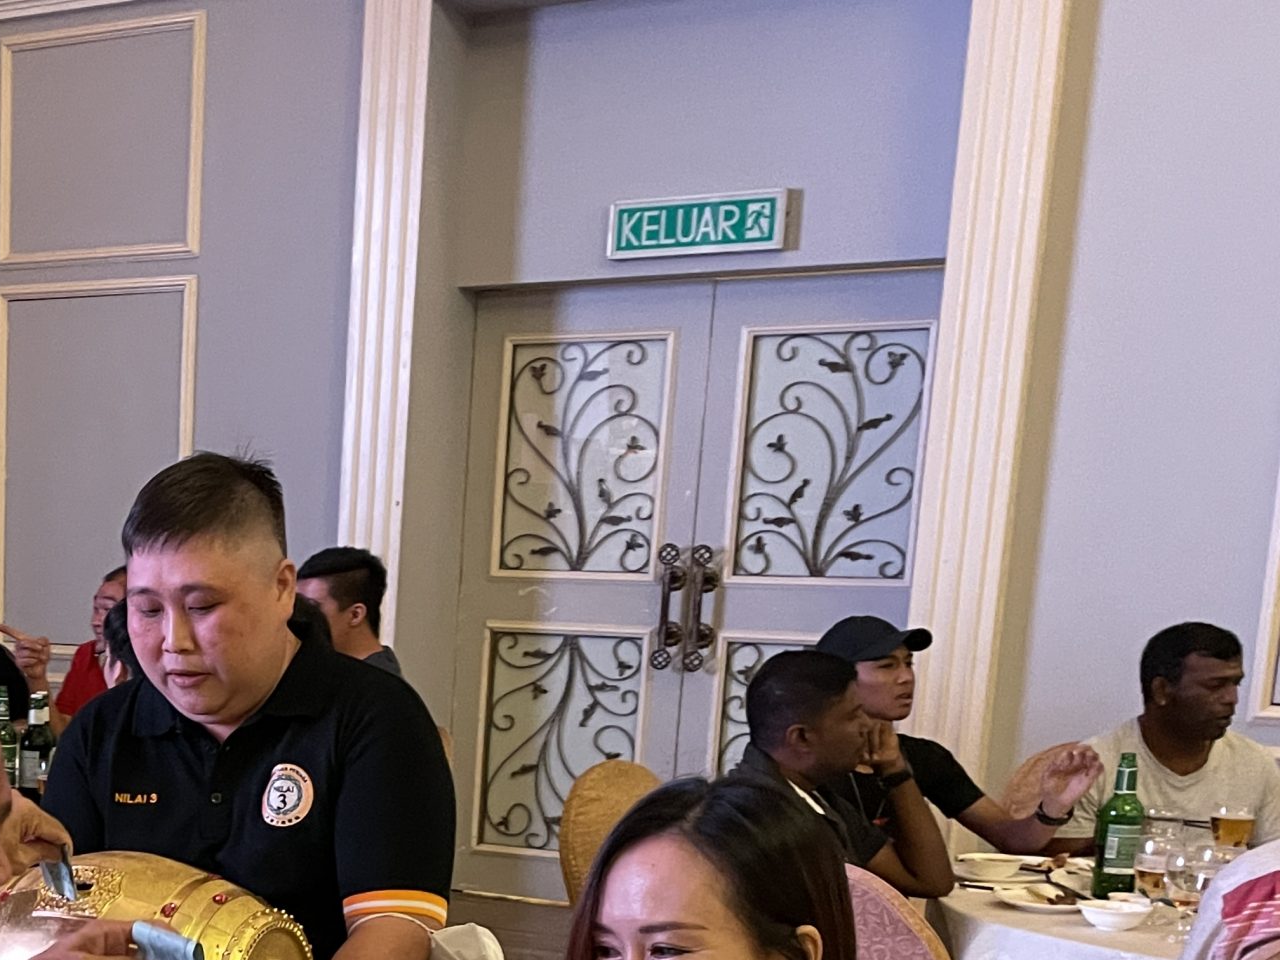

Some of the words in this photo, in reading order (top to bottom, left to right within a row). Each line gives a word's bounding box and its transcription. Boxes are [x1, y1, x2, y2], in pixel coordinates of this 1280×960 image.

[620, 205, 741, 247] KELUAR
[115, 792, 147, 804] NILAI
[150, 793, 158, 804] 3
